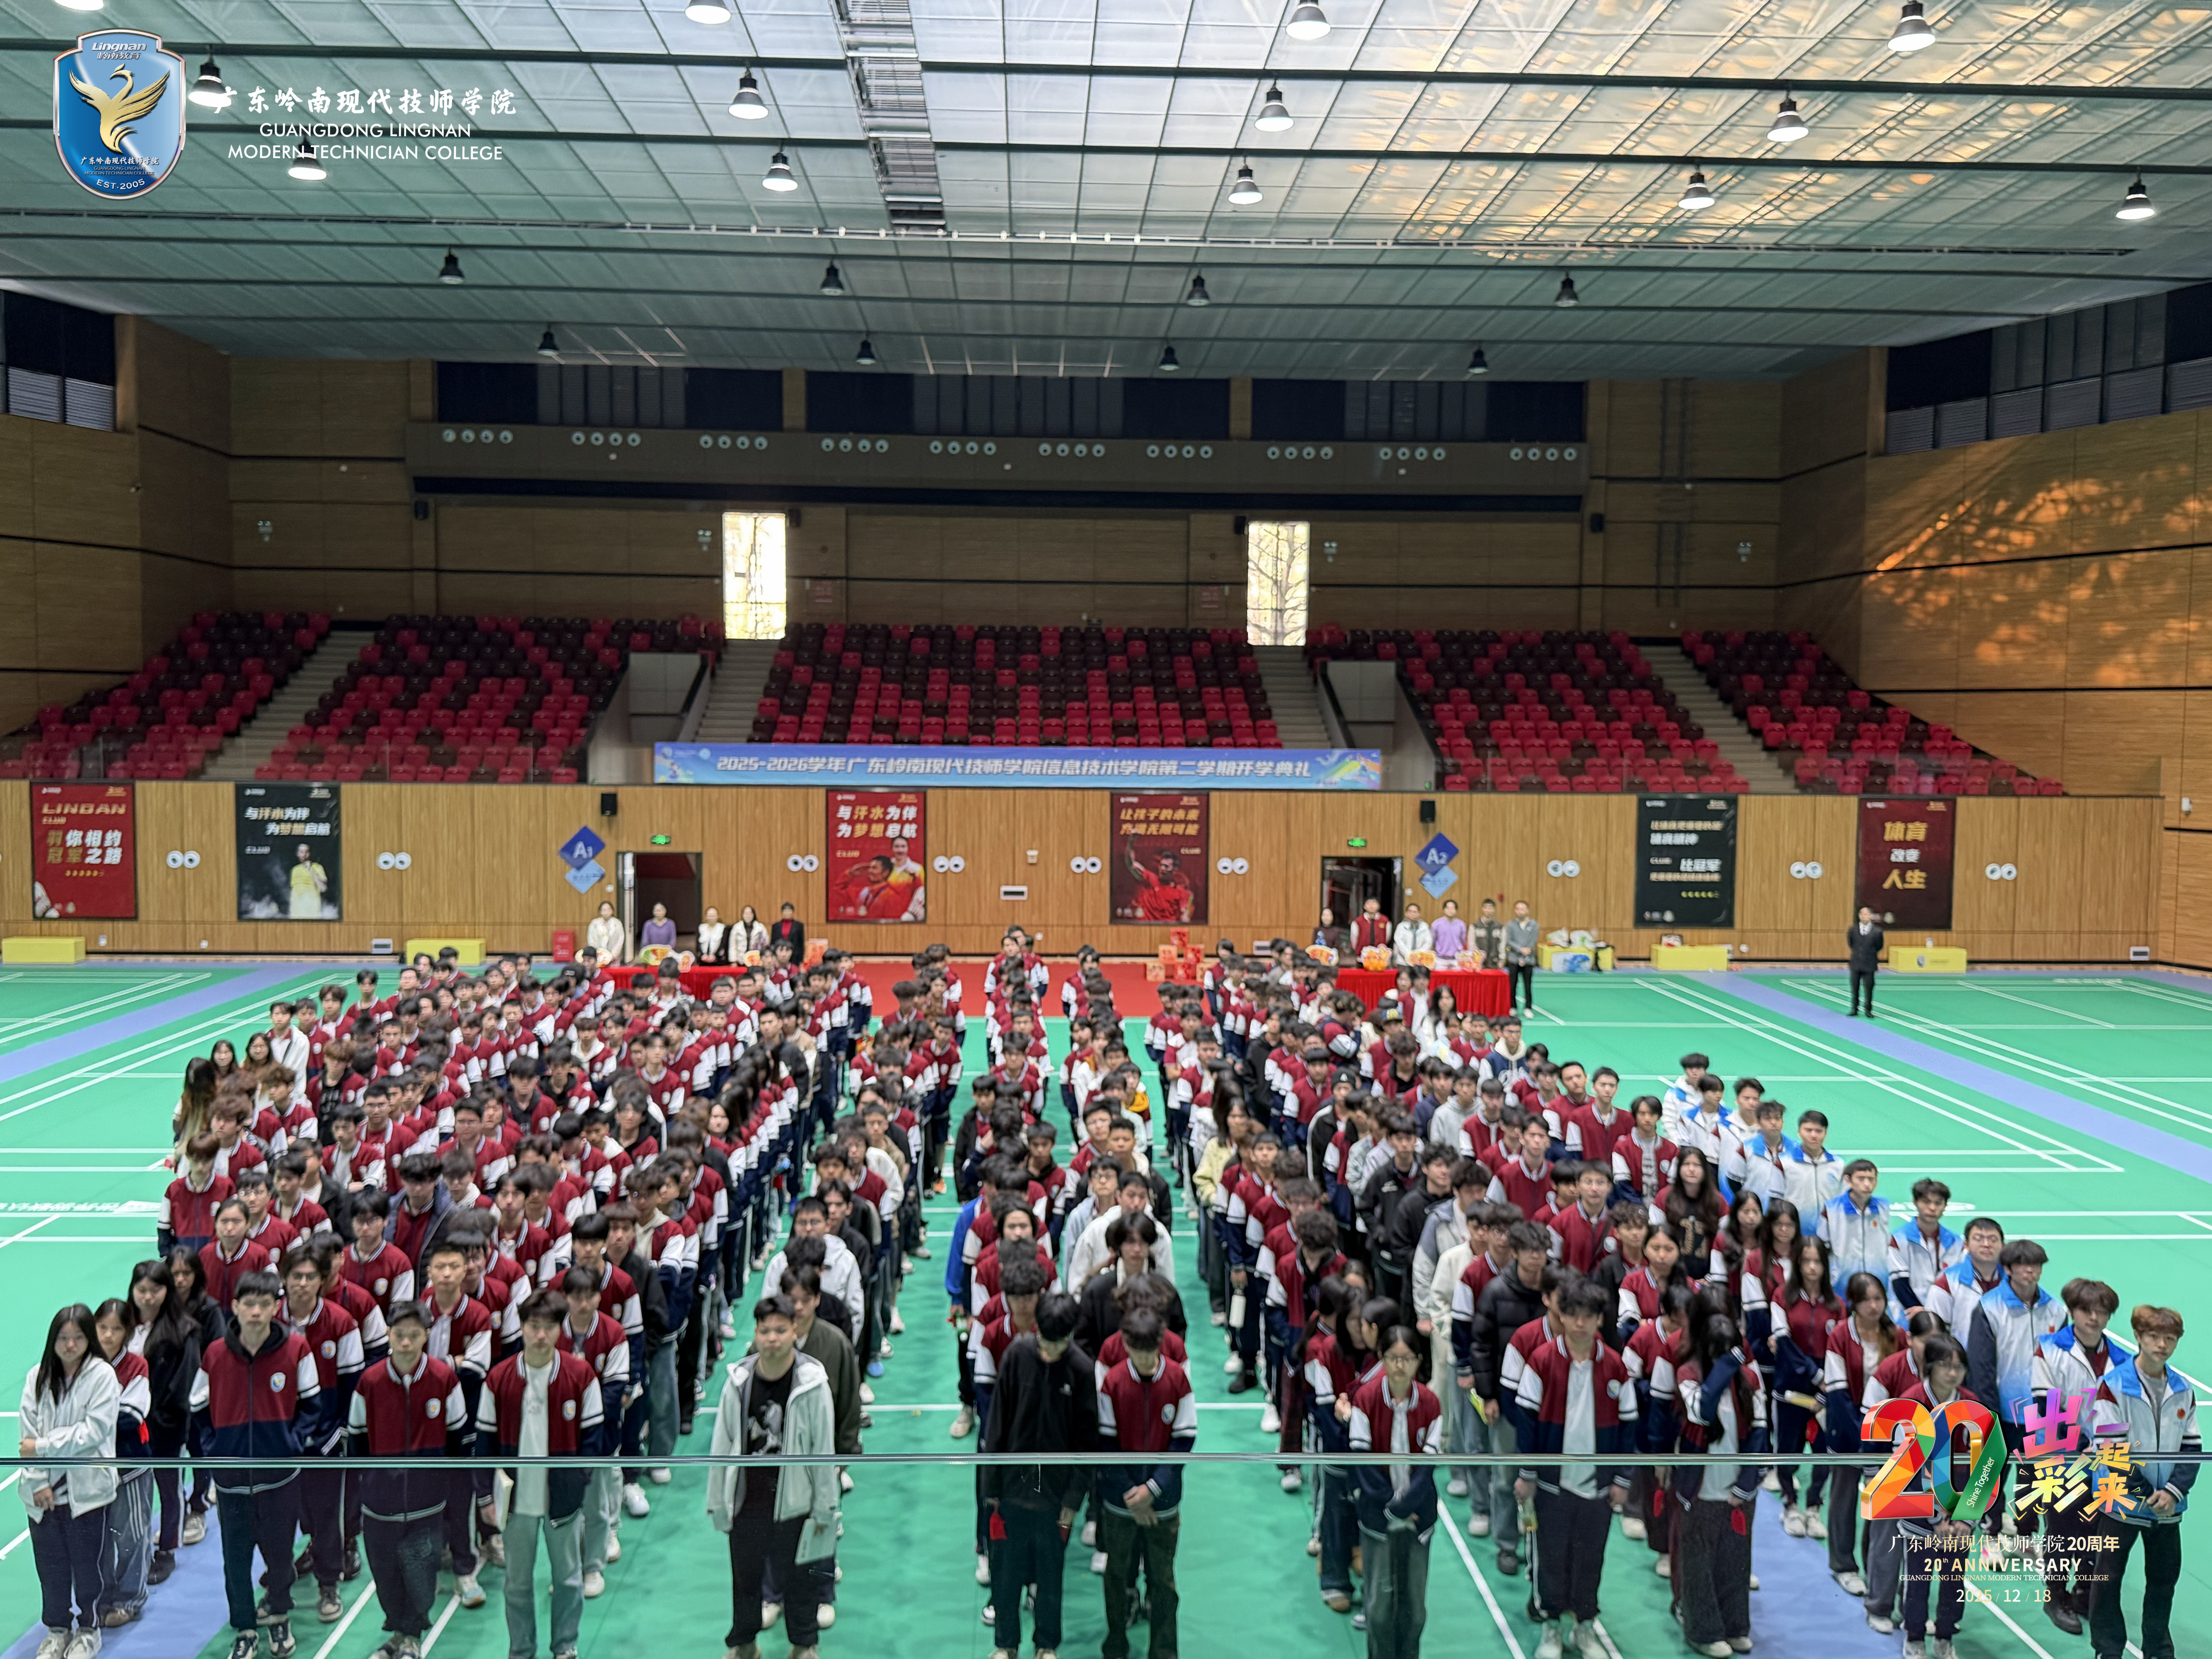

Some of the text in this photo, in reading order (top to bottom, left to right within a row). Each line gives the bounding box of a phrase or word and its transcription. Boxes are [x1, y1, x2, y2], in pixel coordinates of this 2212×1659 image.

[836, 805, 918, 820] 与汗水为伴
[1426, 847, 1448, 865] A2
[1882, 869, 1927, 889] 人生
